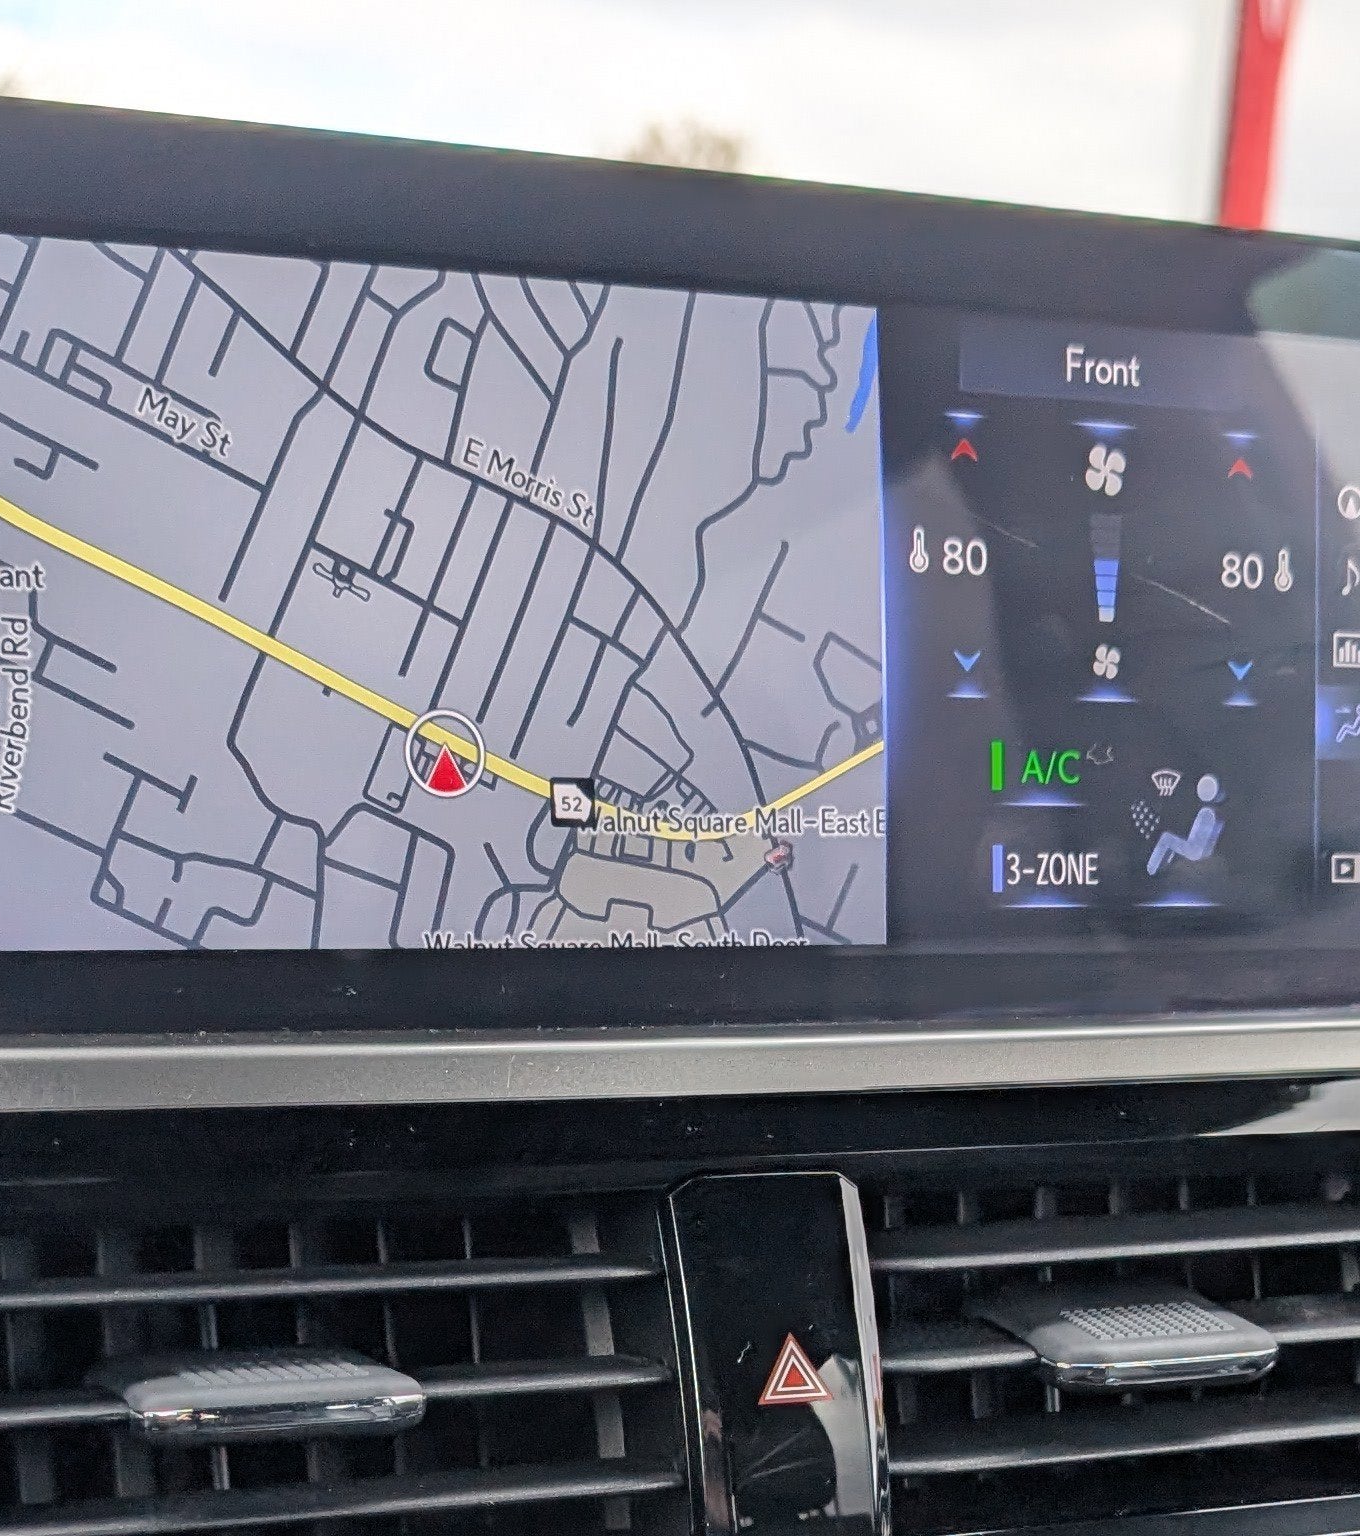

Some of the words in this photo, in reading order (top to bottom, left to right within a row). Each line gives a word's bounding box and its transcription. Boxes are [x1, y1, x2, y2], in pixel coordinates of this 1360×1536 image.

[1065, 346, 1140, 388] Front
[138, 388, 195, 444] May
[199, 416, 232, 457] St
[462, 440, 482, 465] E
[487, 450, 563, 508] Morris
[565, 494, 594, 527] St
[942, 537, 988, 576] 80
[1221, 552, 1263, 590] 80
[1, 617, 30, 659] Rd
[1021, 750, 1081, 785] A/C
[561, 798, 583, 813] 52
[668, 807, 747, 840] Square
[1005, 853, 1099, 886] 3-ZONE
